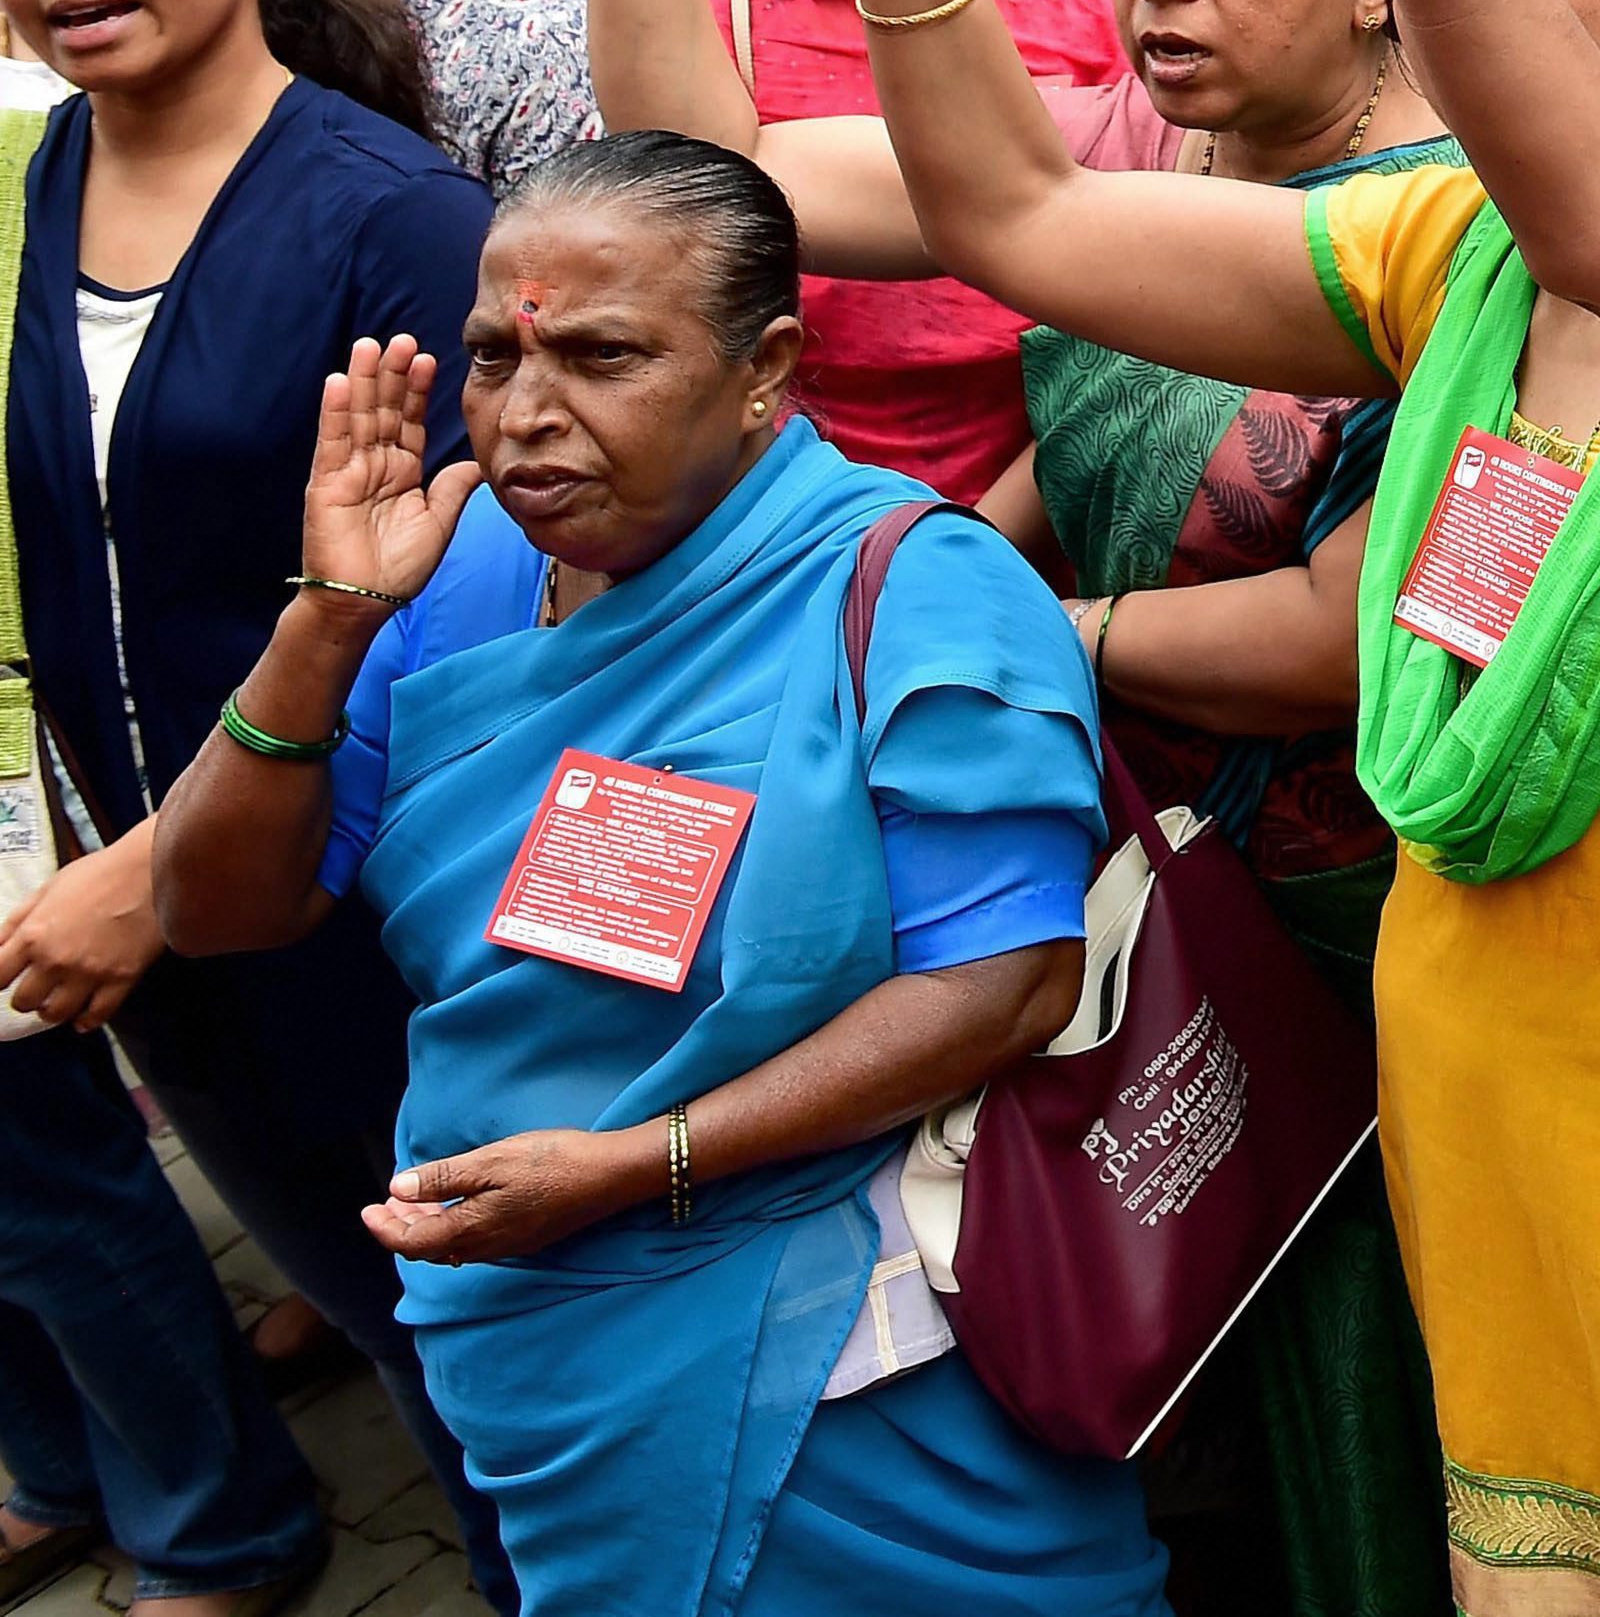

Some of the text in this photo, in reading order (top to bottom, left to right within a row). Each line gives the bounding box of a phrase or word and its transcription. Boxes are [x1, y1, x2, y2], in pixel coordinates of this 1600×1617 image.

[1118, 1085, 1139, 1105] Ph
[1133, 1083, 1160, 1111] Cell
[1179, 1042, 1236, 1135] Jewell
[1099, 1021, 1226, 1193] Priyadarshini
[1080, 1127, 1119, 1161] PJ
